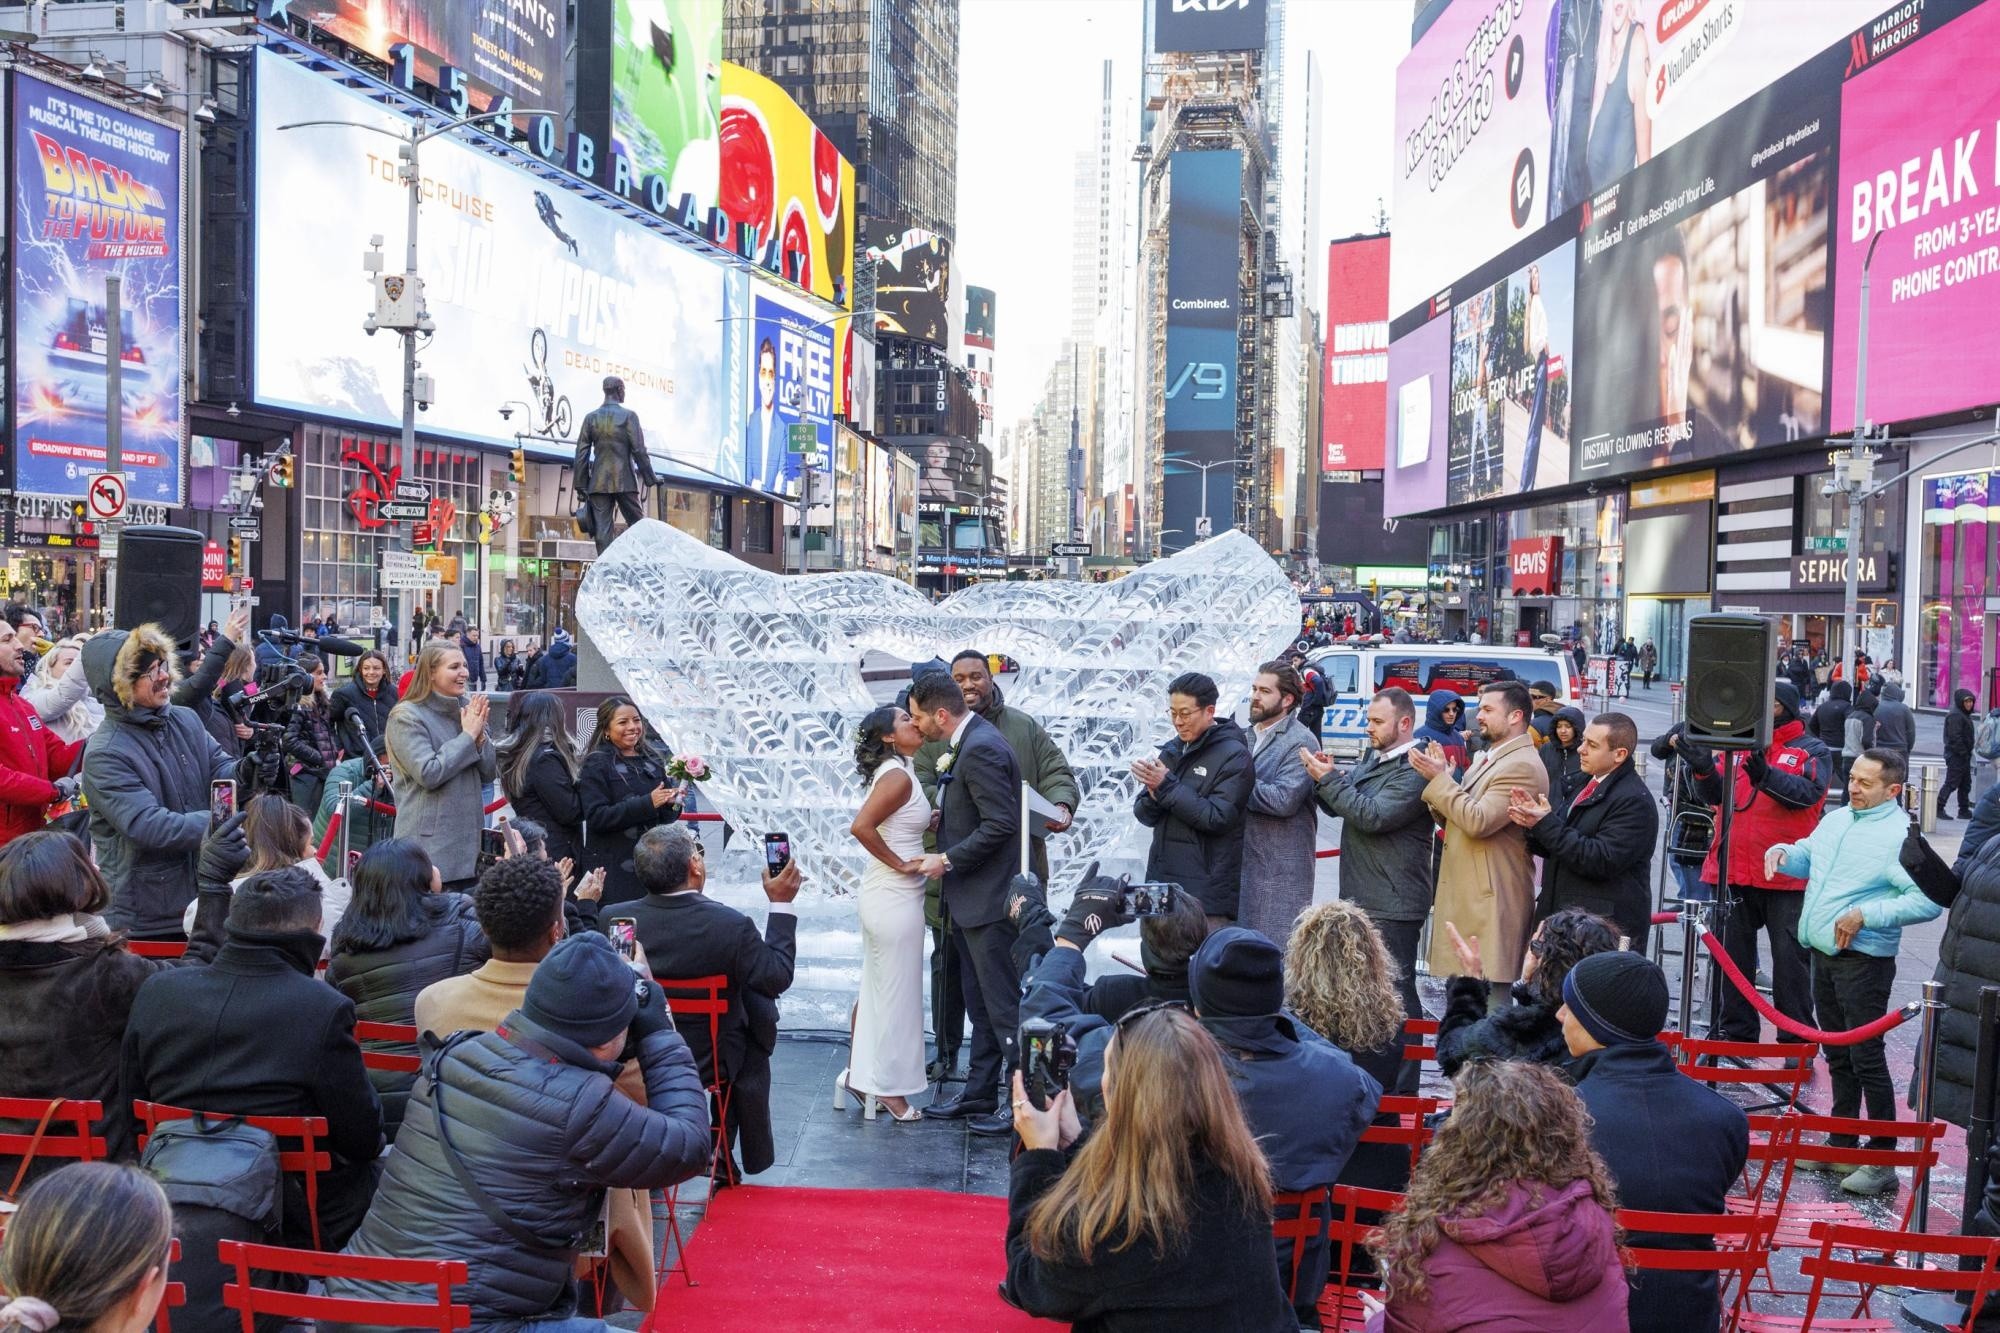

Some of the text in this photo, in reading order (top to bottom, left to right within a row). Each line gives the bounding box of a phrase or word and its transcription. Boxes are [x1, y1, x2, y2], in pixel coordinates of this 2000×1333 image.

[506, 20, 535, 47] MUSICAL
[1872, 0, 1925, 38] MARRIOTT
[1872, 18, 1920, 57] MARQUIS
[472, 32, 498, 56] TICKETS
[498, 49, 511, 64] ON
[511, 55, 526, 73] SALE
[526, 64, 544, 82] NOW
[1667, 4, 1733, 87] YouTube Shorts
[48, 97, 155, 145] IT'S TIME TO CHANGE
[399, 44, 555, 158] 1540
[1406, 96, 1437, 179] Karol
[1439, 78, 1450, 126] G
[1453, 59, 1464, 109] &
[29, 105, 170, 165] MUSICAL THEATER HISTORY
[1429, 69, 1494, 192] CONTIGO
[29, 127, 147, 212] BACK
[1852, 129, 1981, 243] BREAK
[423, 177, 494, 222] CRUISE
[577, 133, 808, 288] BROADWAY
[1593, 184, 1620, 206] MARRIOTT
[1627, 218, 1638, 235] Get
[1639, 215, 1650, 231] the
[1649, 204, 1663, 224] Best
[1663, 197, 1677, 216] Skin
[1677, 193, 1685, 208] of
[1685, 185, 1701, 202] Your
[41, 220, 72, 239] THE
[46, 193, 166, 241] TO FUTURE
[1914, 205, 2000, 260] FROM 3-YE
[104, 244, 165, 256] THE MUSICAL
[885, 233, 896, 245] 15
[1892, 246, 2000, 304] PHONE CONTR
[1172, 298, 1230, 310] Combined.
[565, 350, 674, 394] DEAD RECKONING
[779, 329, 831, 392] FREE
[816, 390, 831, 417] TV
[936, 370, 945, 411] 1500
[1488, 376, 1507, 403] FOR
[1515, 364, 1536, 394] LIFE
[32, 442, 72, 455] BROADWAY
[122, 452, 136, 462] AND
[1584, 421, 1693, 461] INSTANT GLOWING RESULTS
[17, 498, 167, 525] GIFTS GAGE
[384, 506, 422, 515] ONE WAY
[400, 487, 427, 497] ONE WAY
[27, 536, 42, 545] Apple
[48, 536, 72, 546] Nikon
[203, 553, 223, 566] MINI
[1815, 539, 1823, 549] W
[1826, 539, 1838, 549] 46
